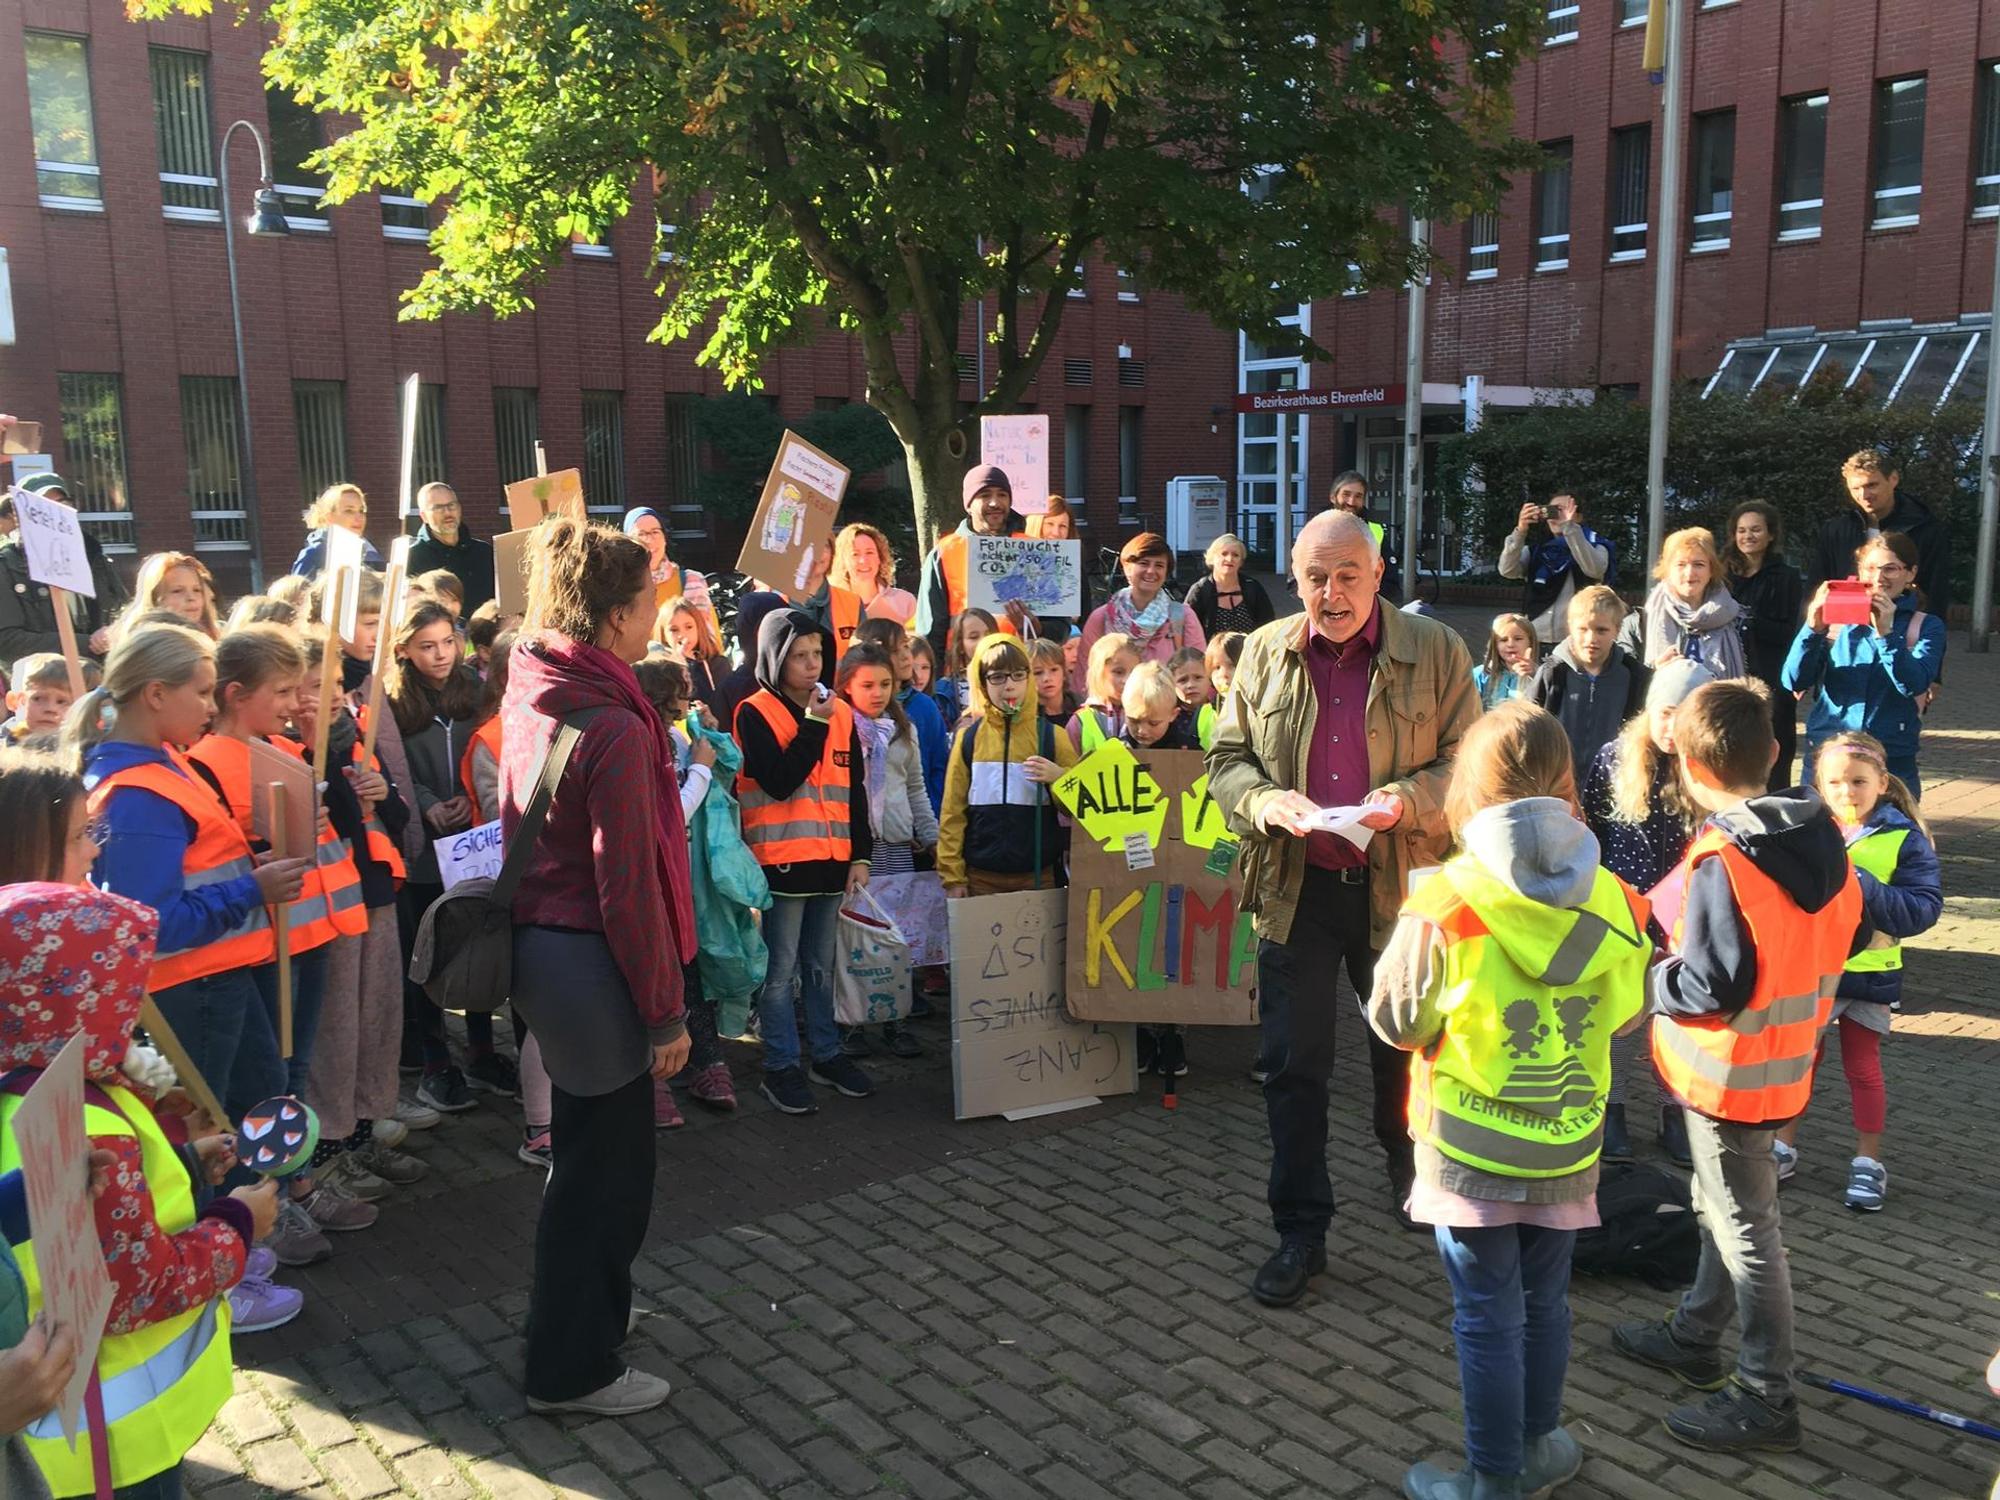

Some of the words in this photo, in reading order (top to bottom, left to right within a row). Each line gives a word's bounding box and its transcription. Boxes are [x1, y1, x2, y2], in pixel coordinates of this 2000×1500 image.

[1253, 393, 1328, 409] Bezirksrathaus
[1331, 388, 1385, 404] Ehrenfeld
[980, 538, 1060, 553] Ferbraucht
[1060, 763, 1155, 819] #ALLE
[1085, 881, 1258, 992] KLIMA
[1004, 1024, 1120, 1084] GANZ
